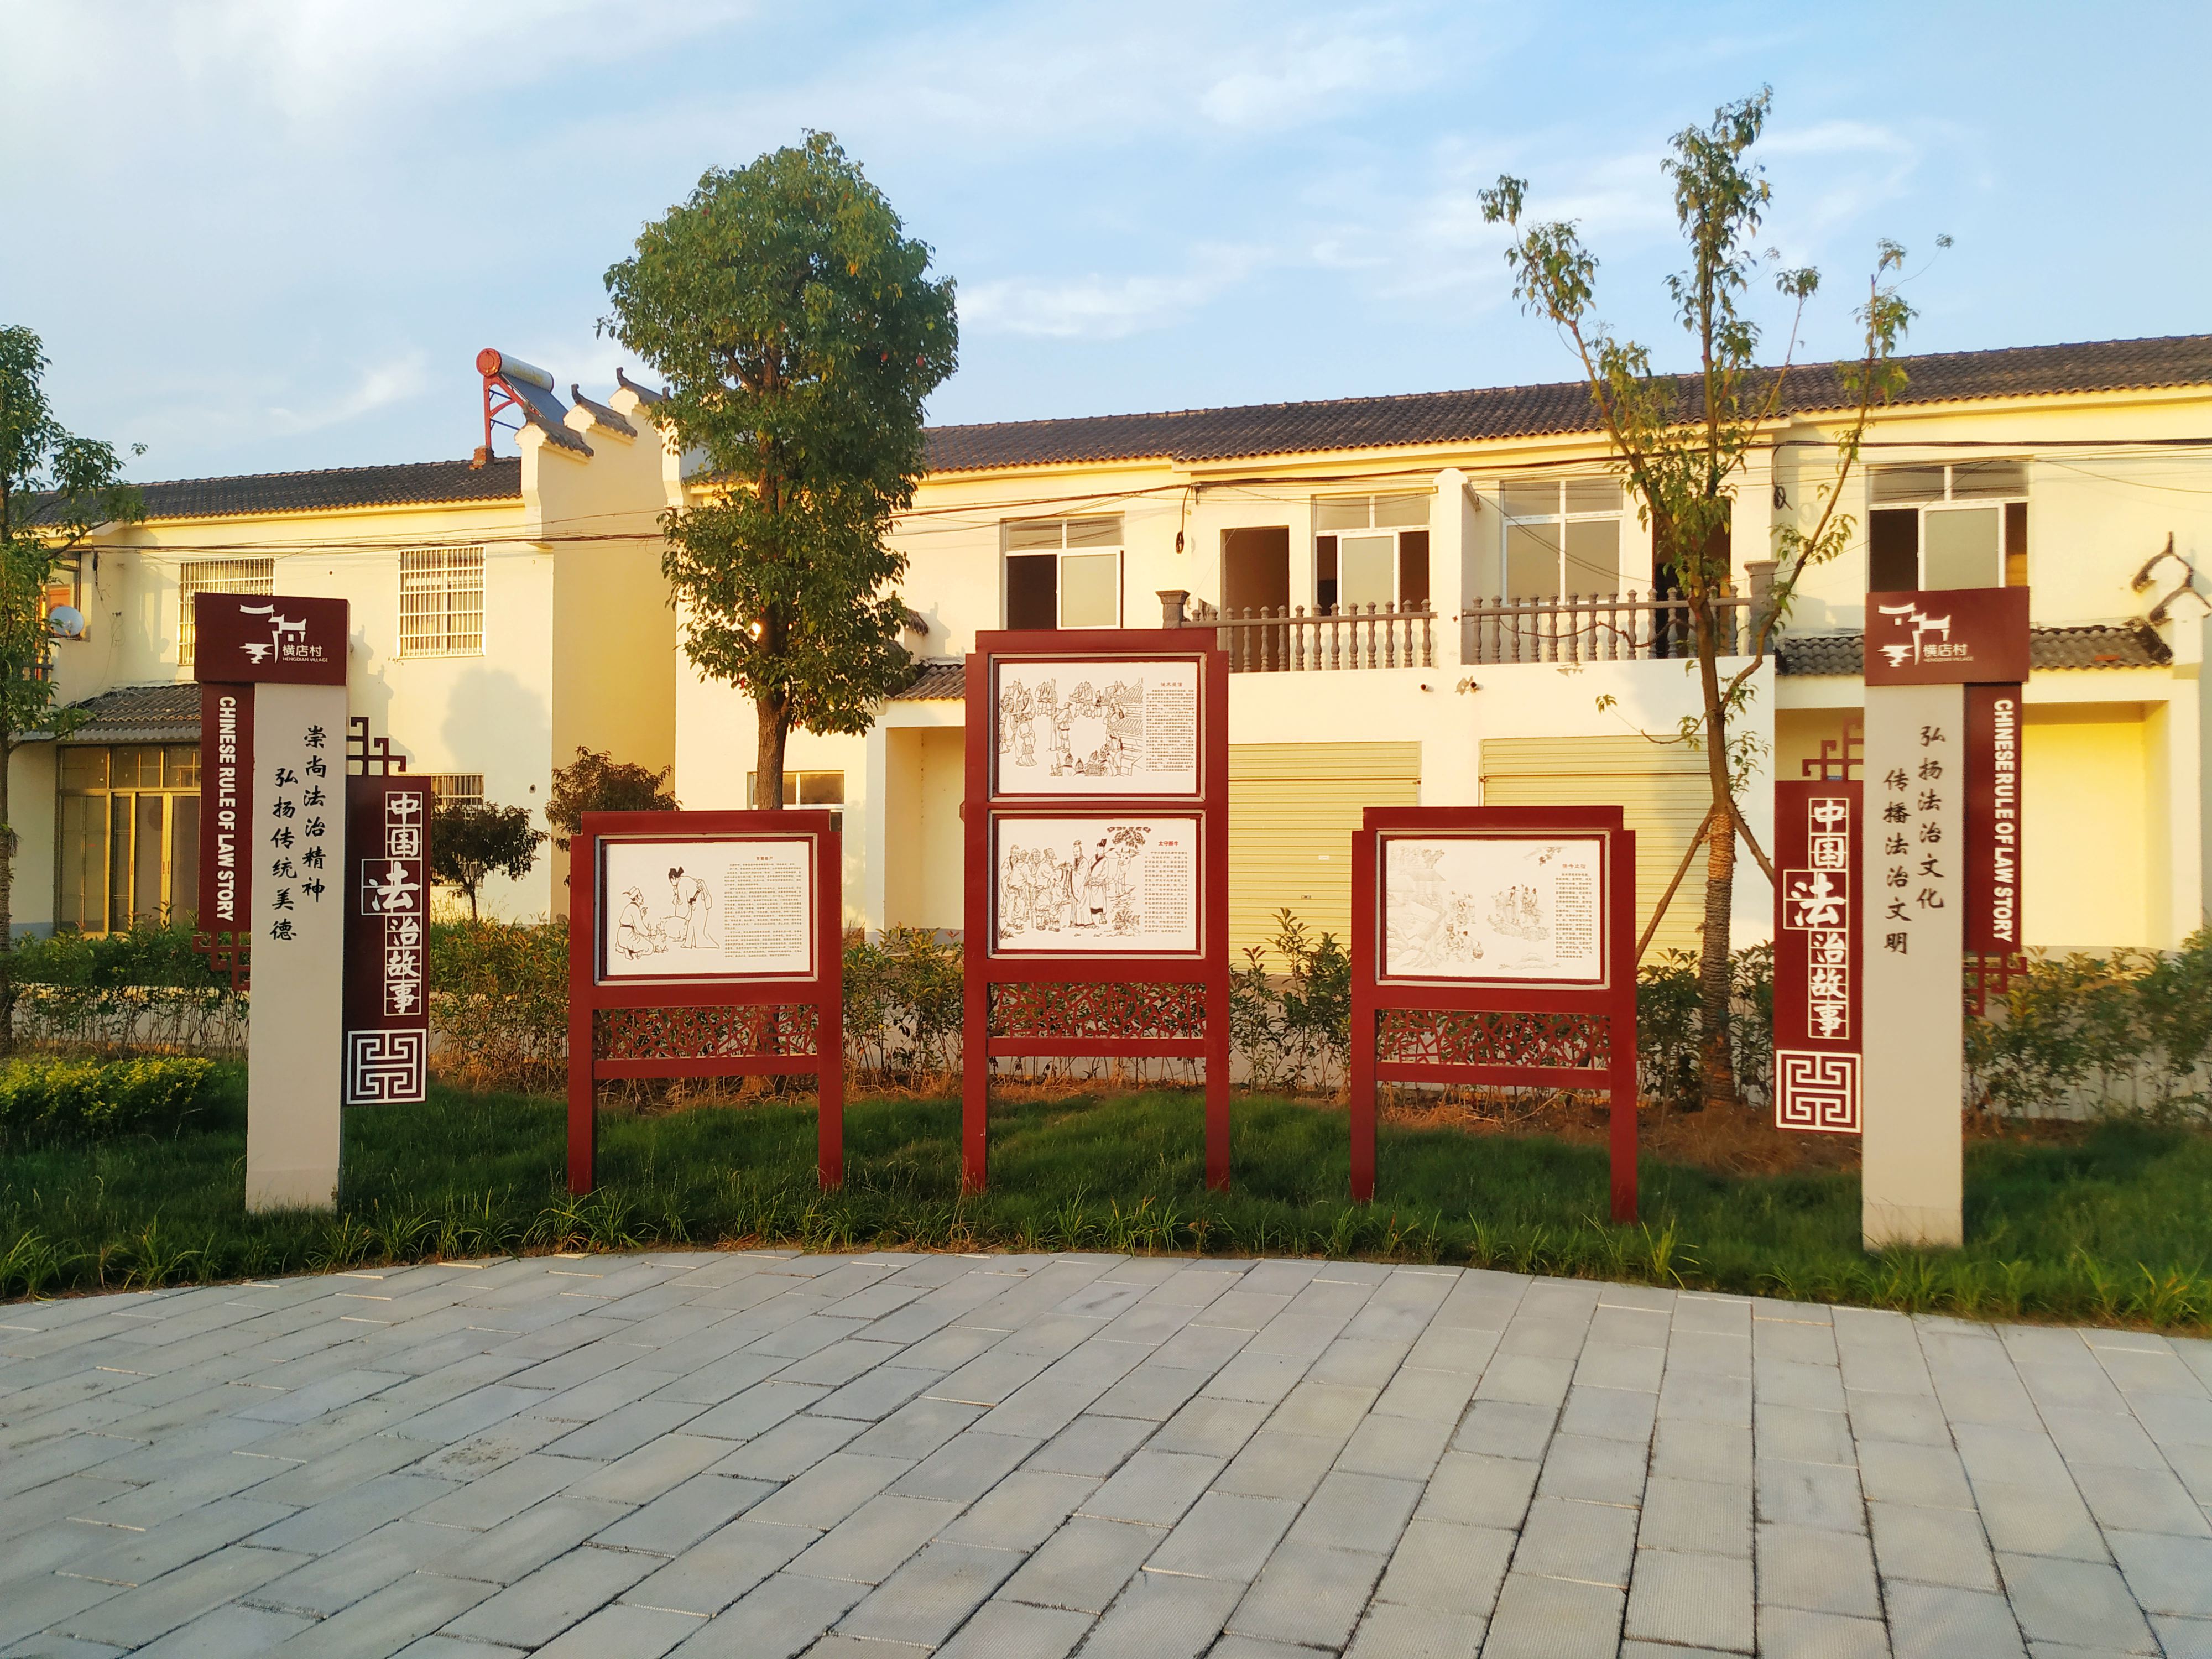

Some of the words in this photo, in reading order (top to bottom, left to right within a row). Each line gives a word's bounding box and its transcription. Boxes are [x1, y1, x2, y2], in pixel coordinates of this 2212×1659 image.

[282, 644, 323, 657] 横店村
[1923, 644, 1968, 658] 横店村
[218, 696, 236, 764] CHINESE
[1994, 699, 2014, 771] CHINESE
[218, 767, 236, 807] RULE
[302, 724, 327, 903] 崇尚法治精神
[1994, 773, 2015, 819] RULE
[218, 810, 236, 831] OF
[1917, 726, 1946, 909] 弘扬法治文化
[1994, 822, 2015, 844] OF
[217, 834, 235, 868] LAW
[269, 768, 299, 941] 弘扬传统美德
[1883, 768, 1912, 955] 传播法治文明
[1994, 847, 2014, 884] LAW
[217, 870, 235, 922] STORY
[368, 793, 420, 1014] 中国法治故事
[1791, 800, 1847, 1037] 中国法治故事
[1992, 886, 2014, 942] STORY
